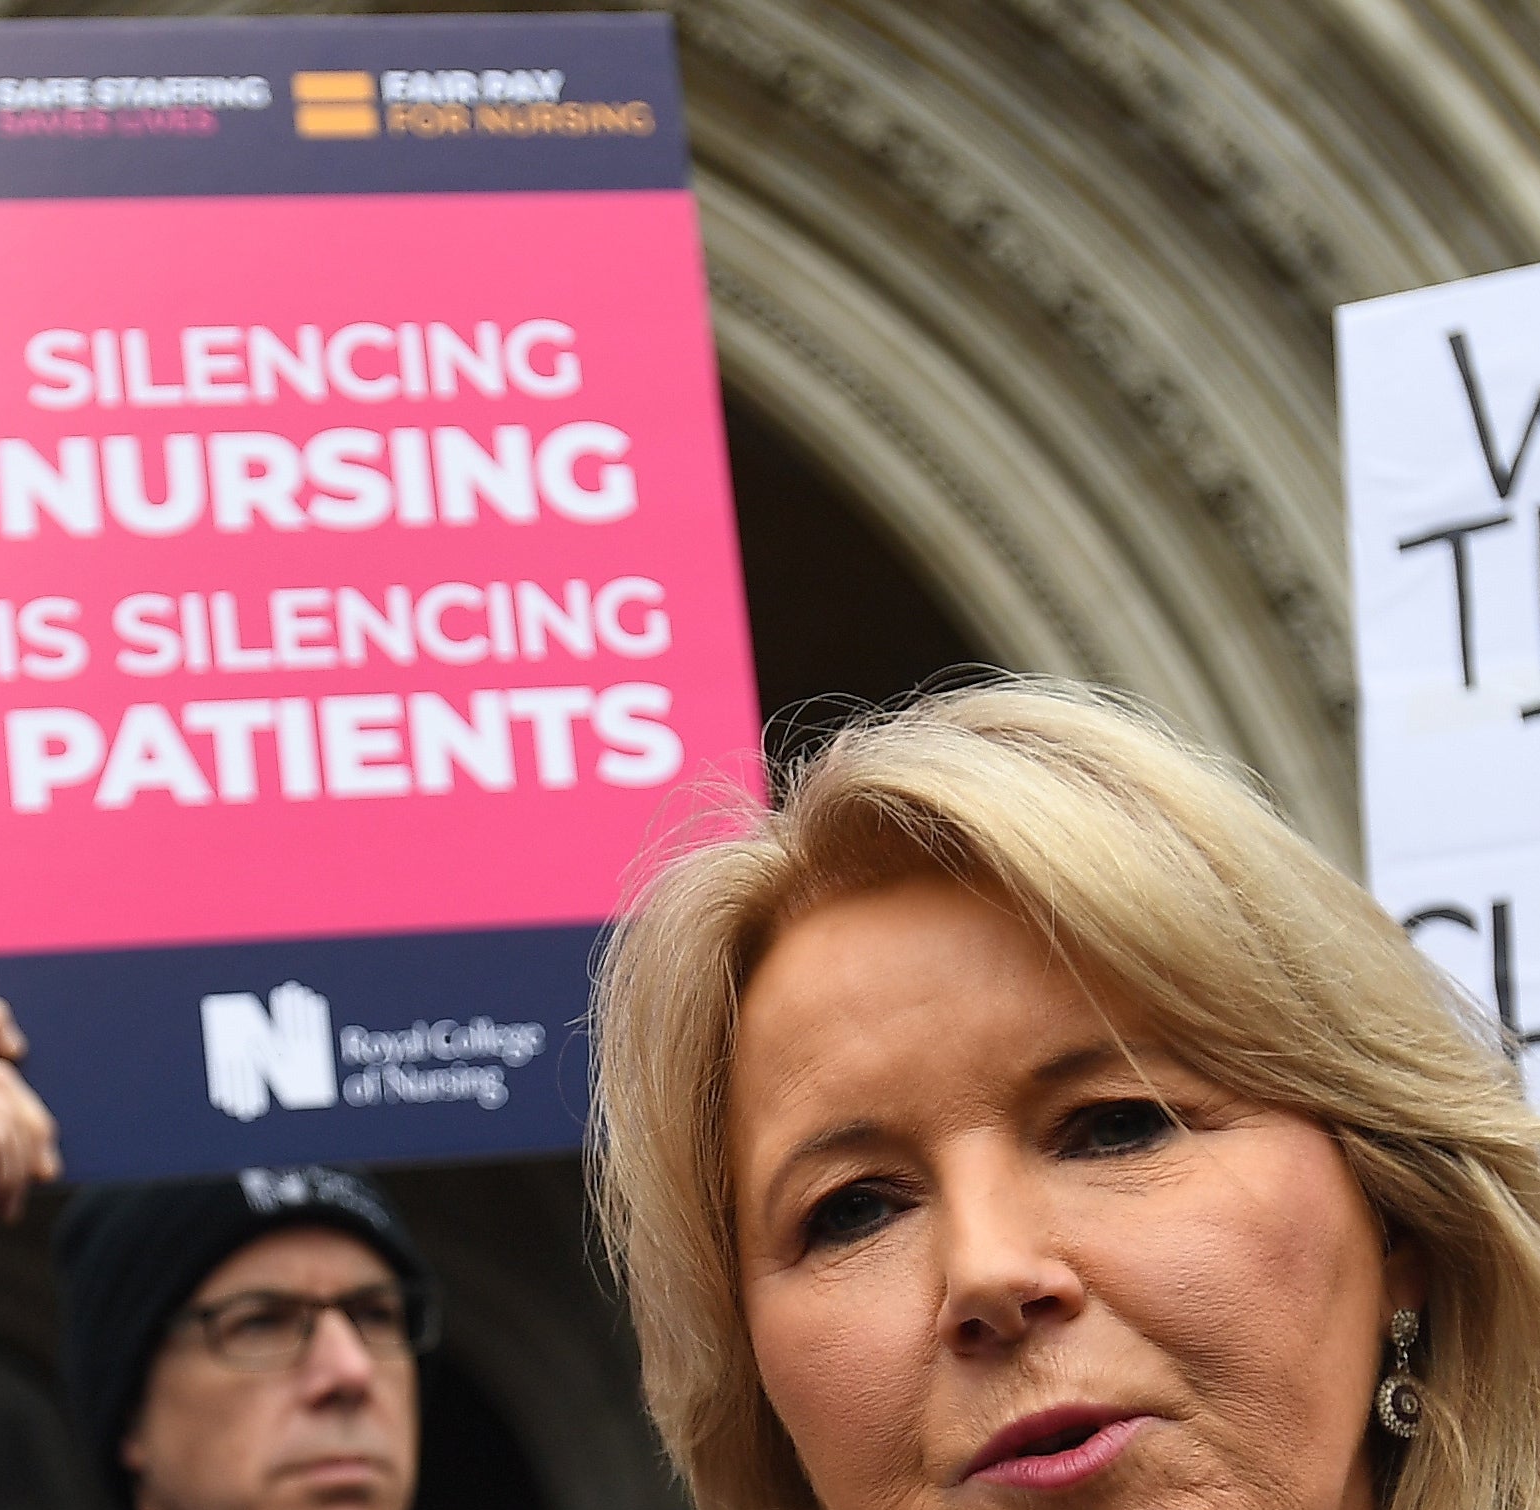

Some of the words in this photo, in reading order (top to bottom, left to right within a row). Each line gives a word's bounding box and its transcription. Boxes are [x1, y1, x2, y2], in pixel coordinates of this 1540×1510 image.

[24, 319, 582, 409] SILENCING
[111, 576, 673, 678] SILENCING
[2, 681, 686, 813] PATIENTS
[339, 1017, 430, 1067] Royal
[430, 1014, 546, 1068] College
[381, 1059, 509, 1110] Nursing
